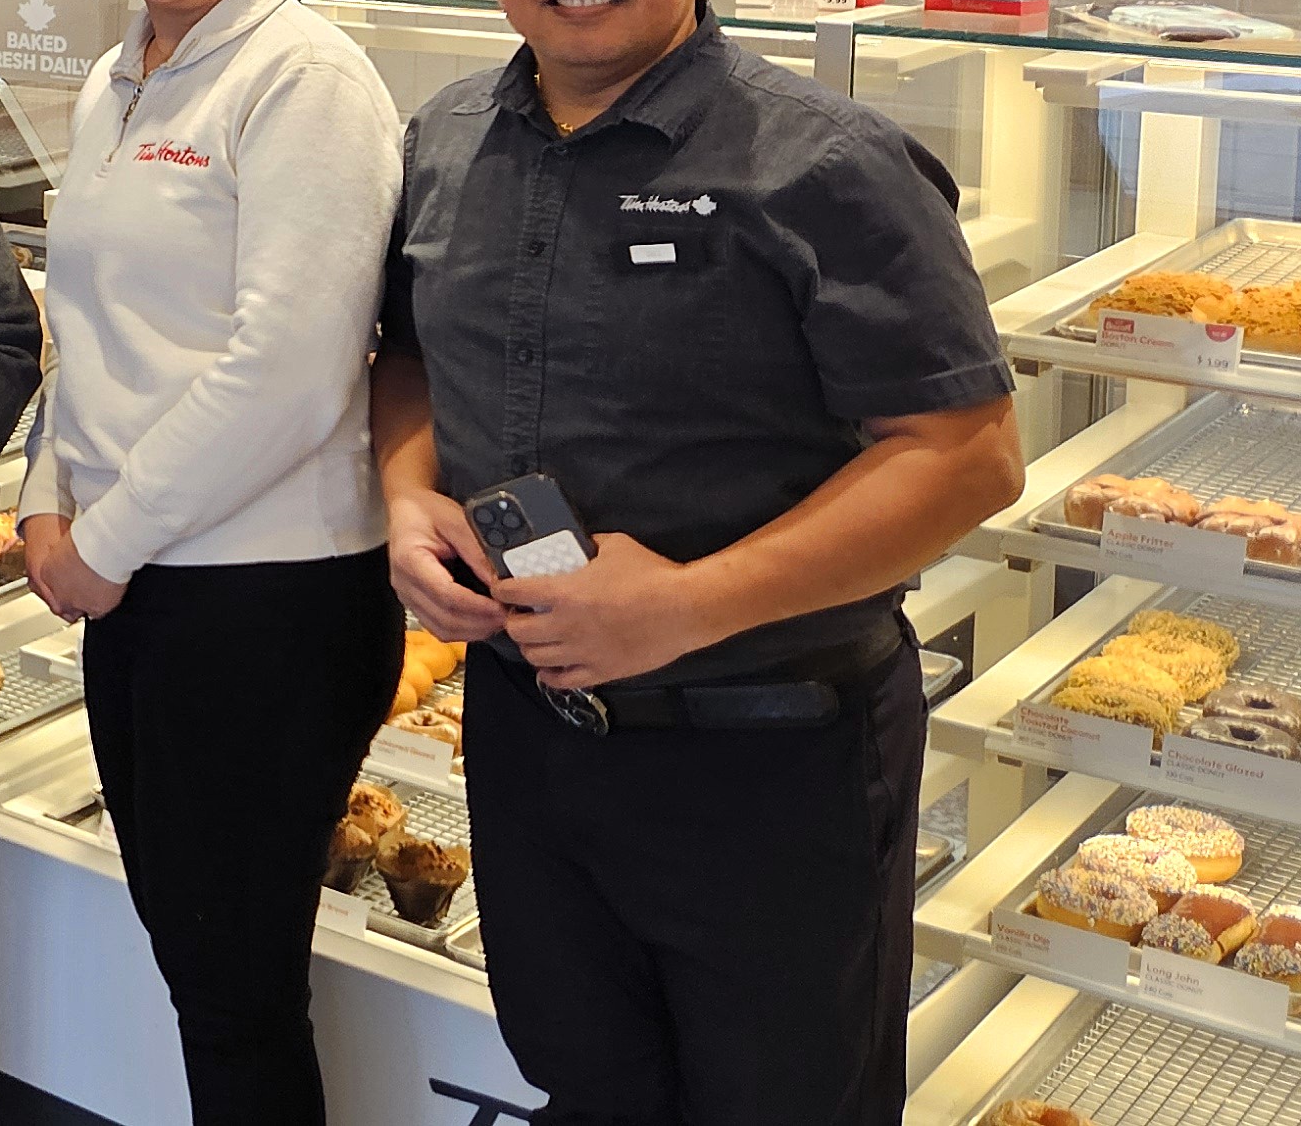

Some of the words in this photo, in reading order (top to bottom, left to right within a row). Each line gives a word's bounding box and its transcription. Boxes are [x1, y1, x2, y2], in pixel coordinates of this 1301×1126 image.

[6, 30, 68, 54] BAKED
[39, 53, 93, 77] DAILY
[133, 142, 154, 162] Tim
[154, 139, 211, 170] Hortons
[1167, 749, 1223, 770] Chocolate
